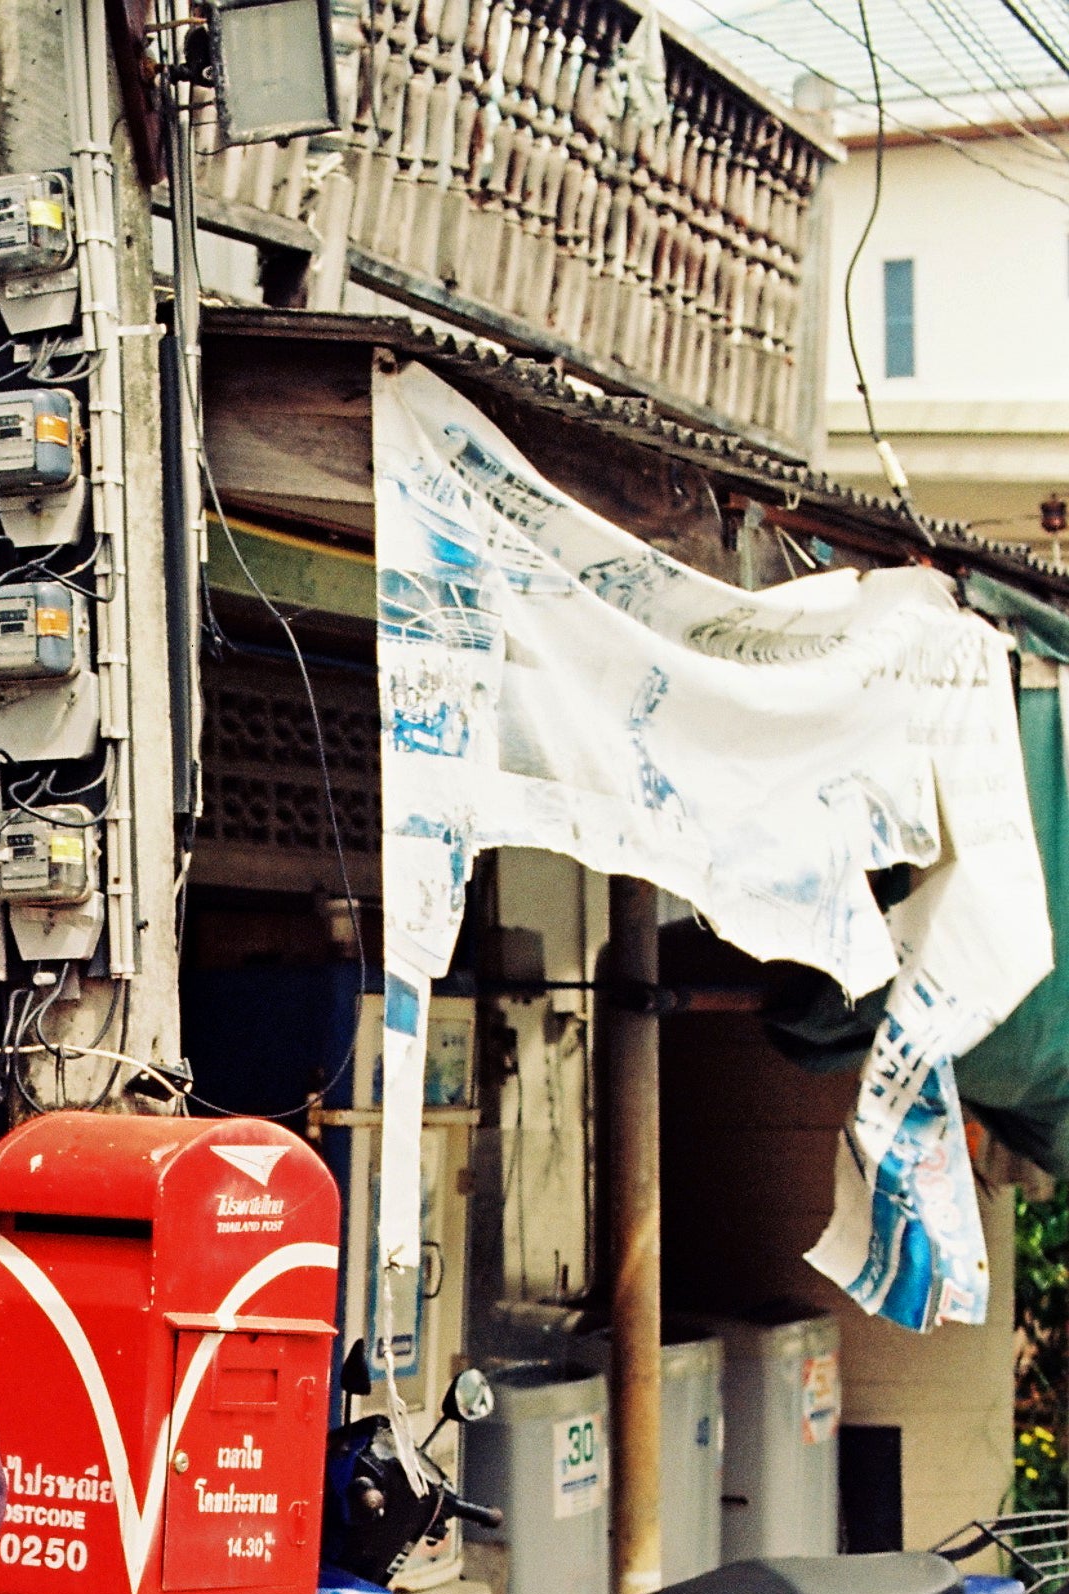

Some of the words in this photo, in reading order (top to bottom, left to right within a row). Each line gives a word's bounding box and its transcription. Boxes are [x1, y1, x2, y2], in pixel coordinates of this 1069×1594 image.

[216, 1221, 259, 1233] THAILAND
[261, 1220, 284, 1232] POST
[567, 1421, 594, 1467] 30
[3, 1503, 86, 1530] STCODE
[227, 1536, 265, 1558] 14.30
